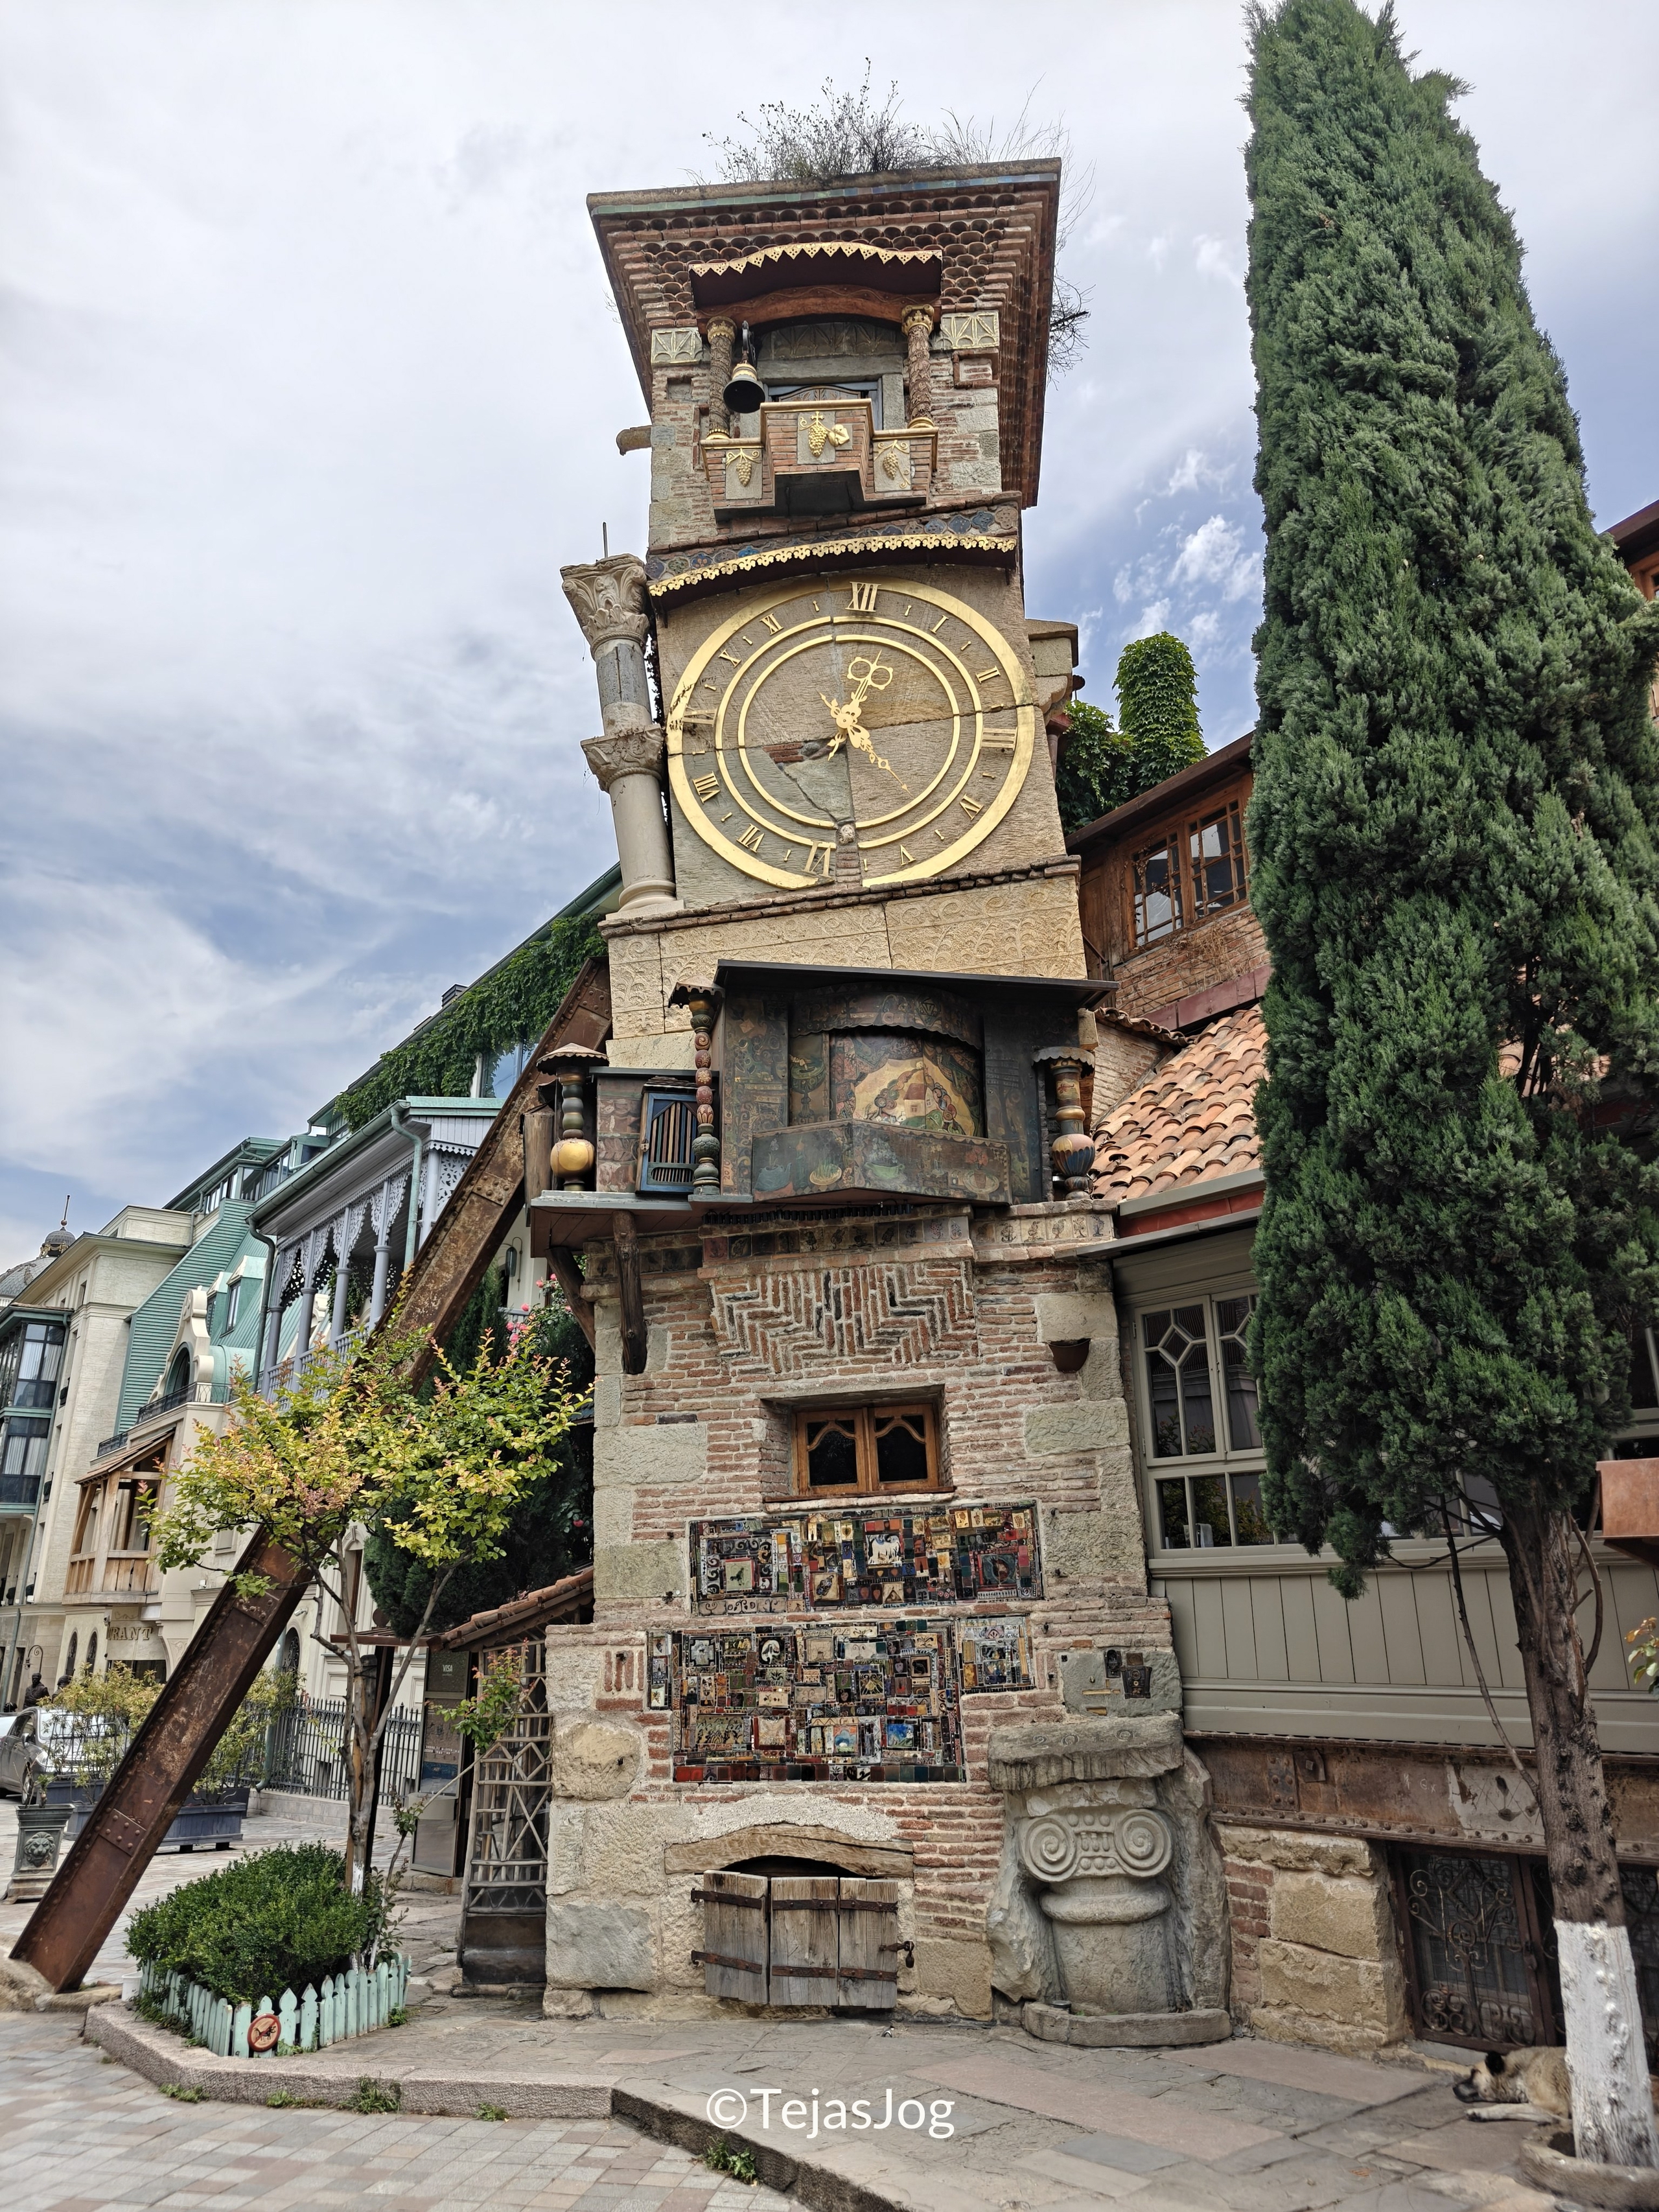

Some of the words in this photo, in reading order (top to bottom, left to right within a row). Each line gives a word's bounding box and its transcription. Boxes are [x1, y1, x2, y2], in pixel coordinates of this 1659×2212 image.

[845, 581, 881, 612] XII
[760, 613, 784, 635] XI
[930, 615, 949, 634] I
[719, 649, 741, 668] X
[975, 666, 1001, 683] II
[980, 727, 1017, 751] III
[692, 771, 721, 804] VIII
[736, 823, 765, 854] VII
[899, 844, 916, 866] V
